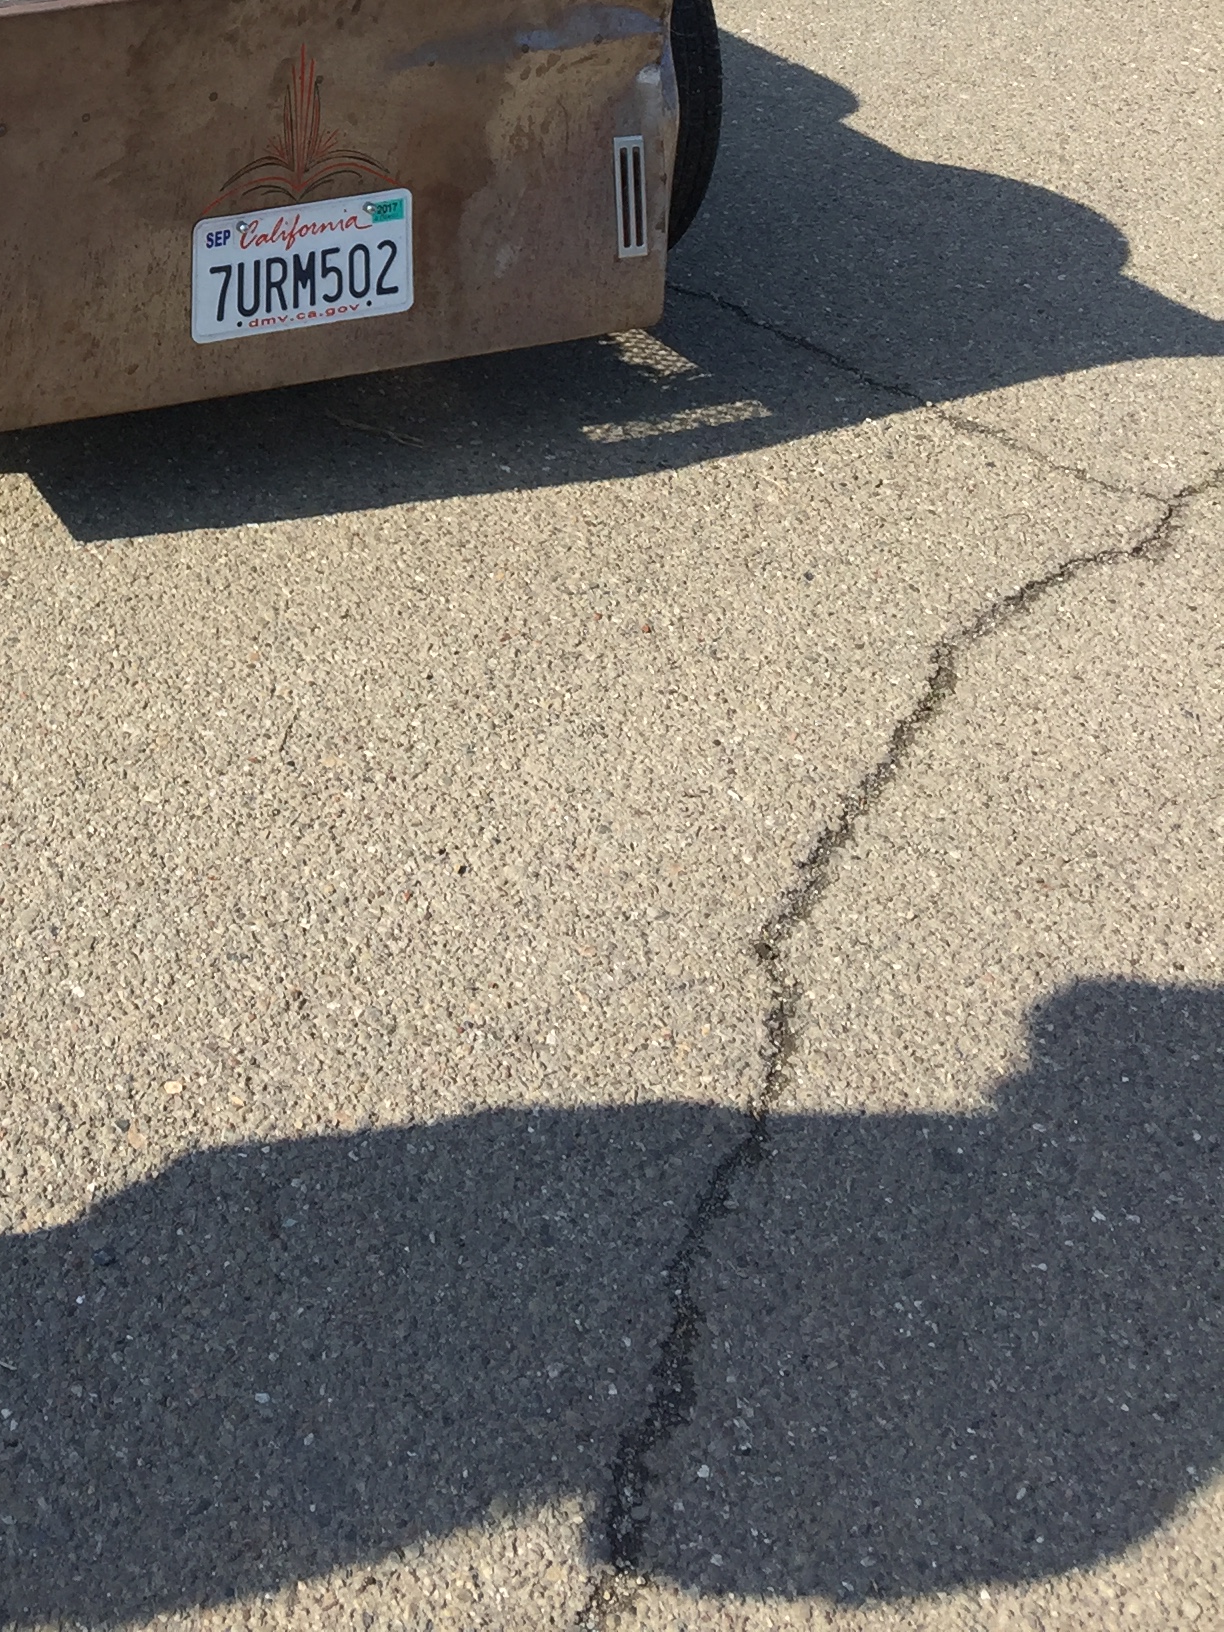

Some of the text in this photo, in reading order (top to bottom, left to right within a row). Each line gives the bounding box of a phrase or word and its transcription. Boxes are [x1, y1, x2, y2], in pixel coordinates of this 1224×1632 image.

[376, 202, 398, 215] 2017
[206, 230, 231, 249] SEP
[239, 214, 372, 251] California
[210, 240, 399, 322] 7URM502
[248, 304, 360, 328] dmv.ca.gov
